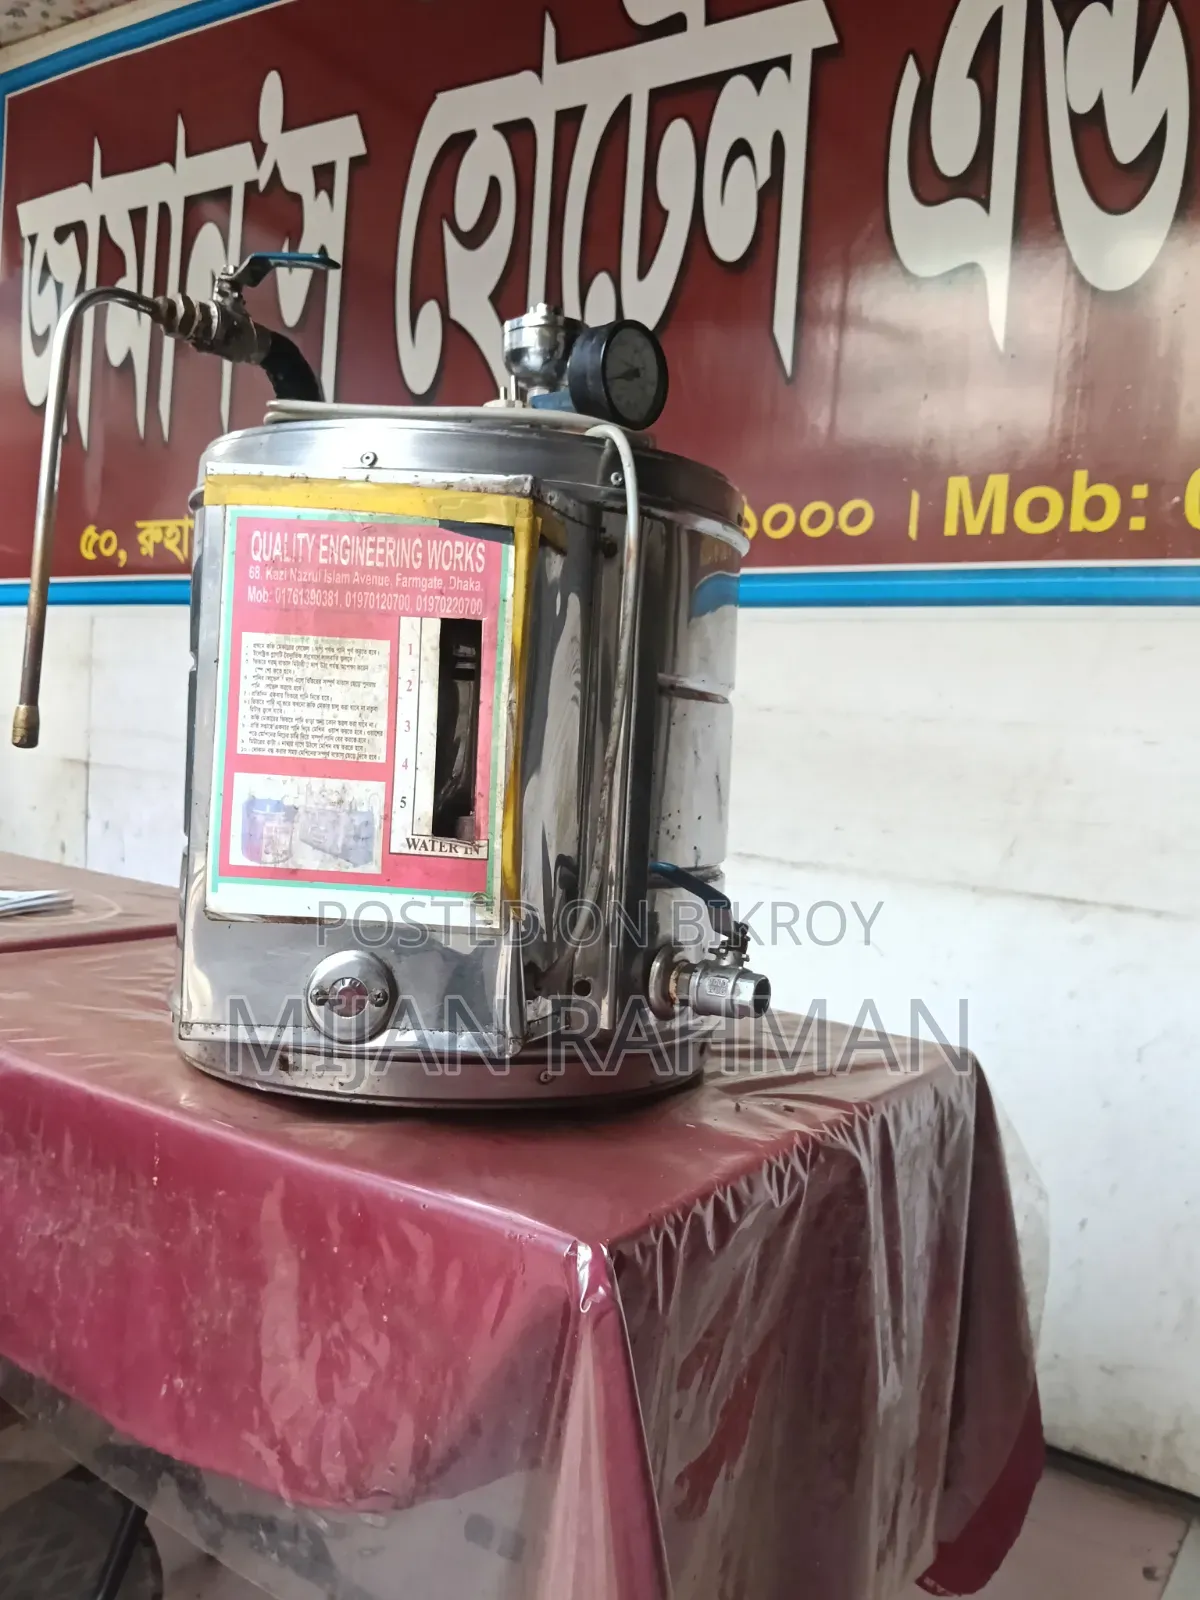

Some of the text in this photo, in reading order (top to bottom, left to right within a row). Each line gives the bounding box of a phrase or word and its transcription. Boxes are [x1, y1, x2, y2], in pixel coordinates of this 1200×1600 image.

[396, 0, 838, 398] হোটেল
[80, 524, 127, 567] ৫০,
[135, 514, 194, 564] রুহা
[943, 469, 1149, 536] Mob:
[251, 530, 486, 573] QUALITY ENGINEERING WORKS
[265, 566, 288, 581] Kazi
[324, 569, 350, 584] Islam
[247, 585, 273, 604] Mob:
[408, 643, 413, 655] 1
[406, 679, 412, 692] 2
[404, 720, 411, 732] 3
[401, 758, 409, 770] 4
[399, 796, 407, 808] 5
[405, 837, 459, 854] WATER
